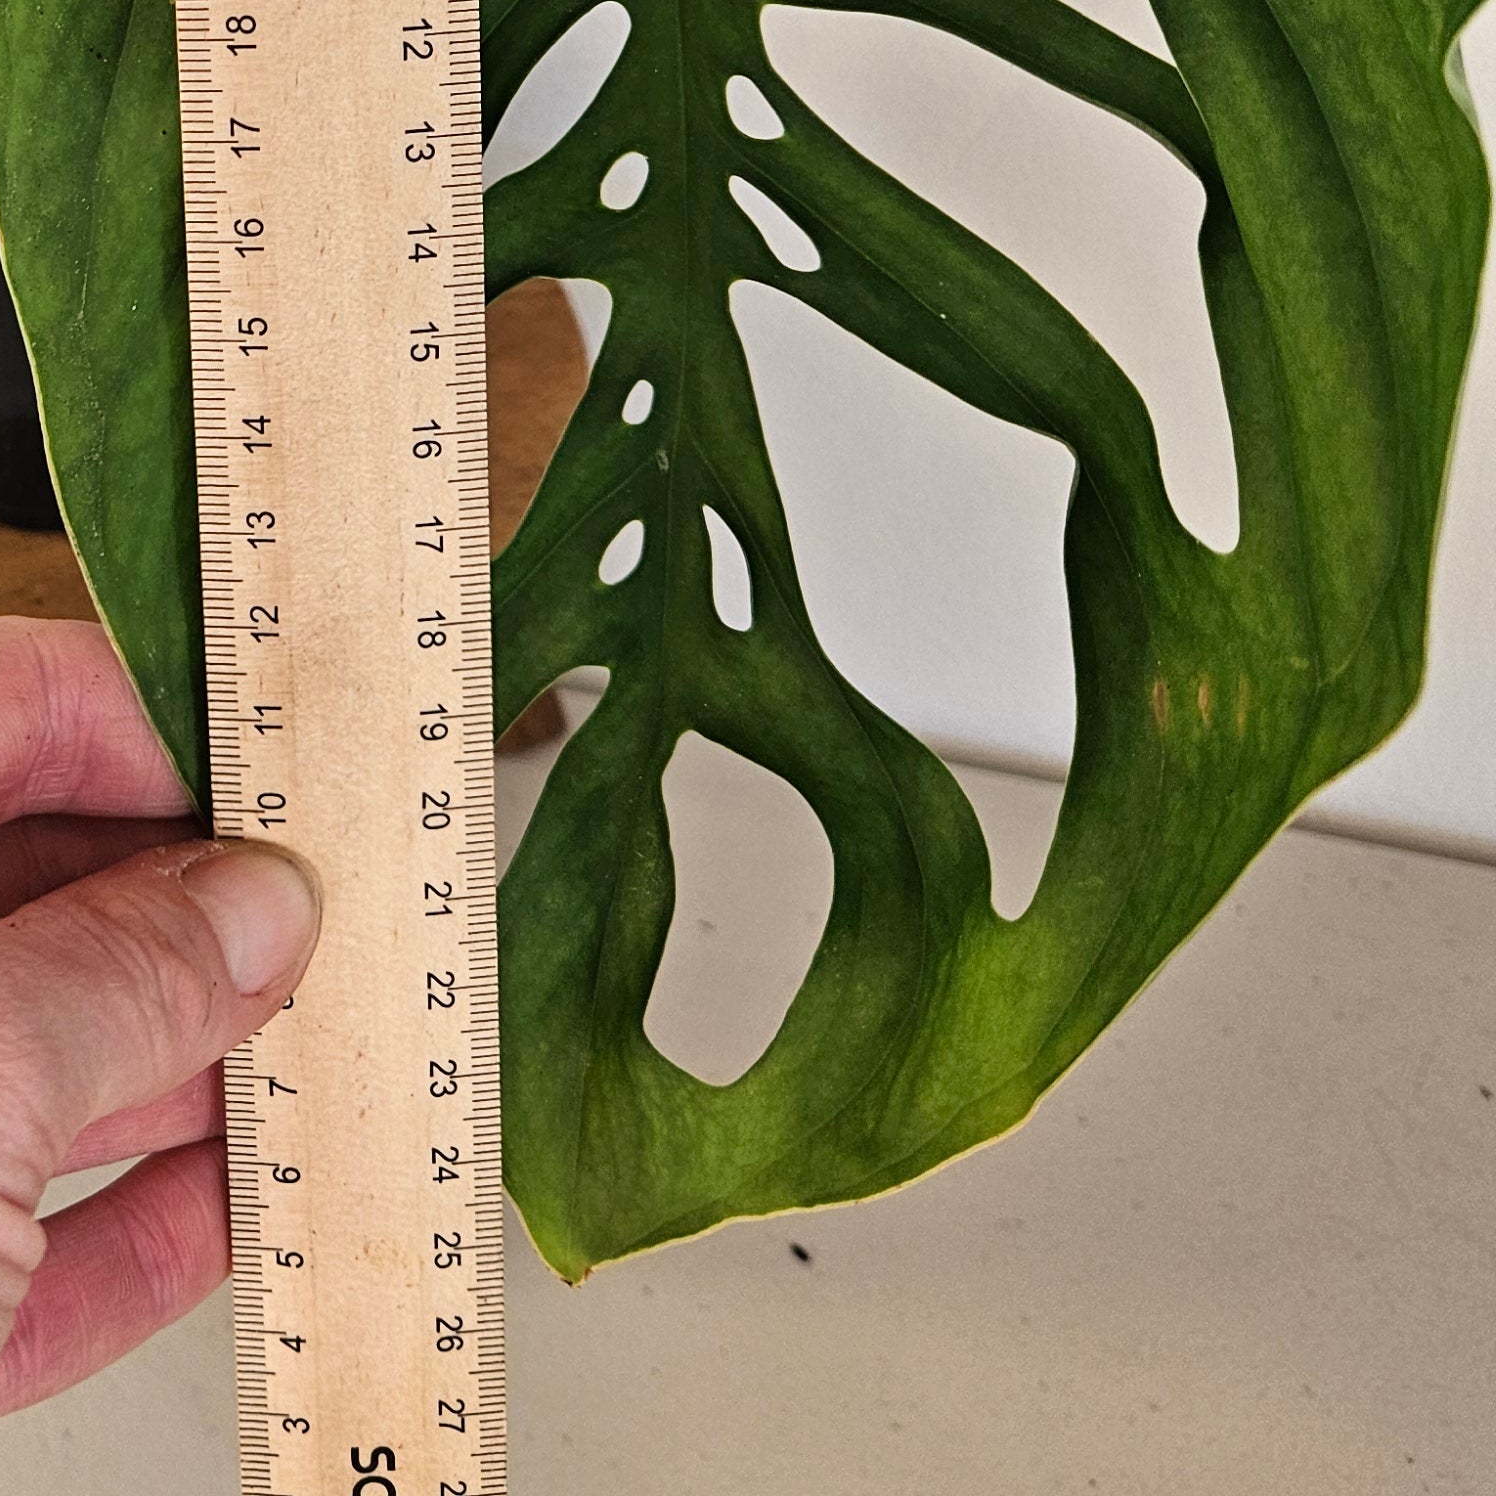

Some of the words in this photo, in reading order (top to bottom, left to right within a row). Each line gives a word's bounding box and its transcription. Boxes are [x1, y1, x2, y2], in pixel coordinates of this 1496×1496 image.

[228, 15, 260, 56] 18
[403, 18, 433, 61] 12
[232, 117, 264, 158] 17
[405, 121, 436, 163] 13
[235, 218, 267, 258] 16
[407, 222, 438, 263] 14
[239, 317, 271, 356] 15
[410, 322, 440, 362] 15
[243, 415, 275, 454] 14
[412, 419, 442, 459] 16
[247, 510, 278, 549] 13
[415, 516, 444, 553] 17
[250, 605, 281, 643] 12
[417, 610, 447, 649] 18
[254, 703, 285, 735] 11
[420, 703, 449, 741] 19
[258, 792, 288, 829] 10
[422, 791, 451, 830] 20
[425, 881, 453, 917] 21
[427, 971, 455, 1010] 22
[269, 1079, 298, 1096] 7
[429, 1060, 457, 1098] 23
[272, 1166, 302, 1184] 6
[432, 1146, 459, 1184] 24
[275, 1251, 305, 1269] 5
[434, 1232, 461, 1269] 25
[279, 1335, 308, 1353] 4
[436, 1316, 463, 1352] 26
[282, 1417, 311, 1434] 3
[438, 1399, 465, 1433] 27
